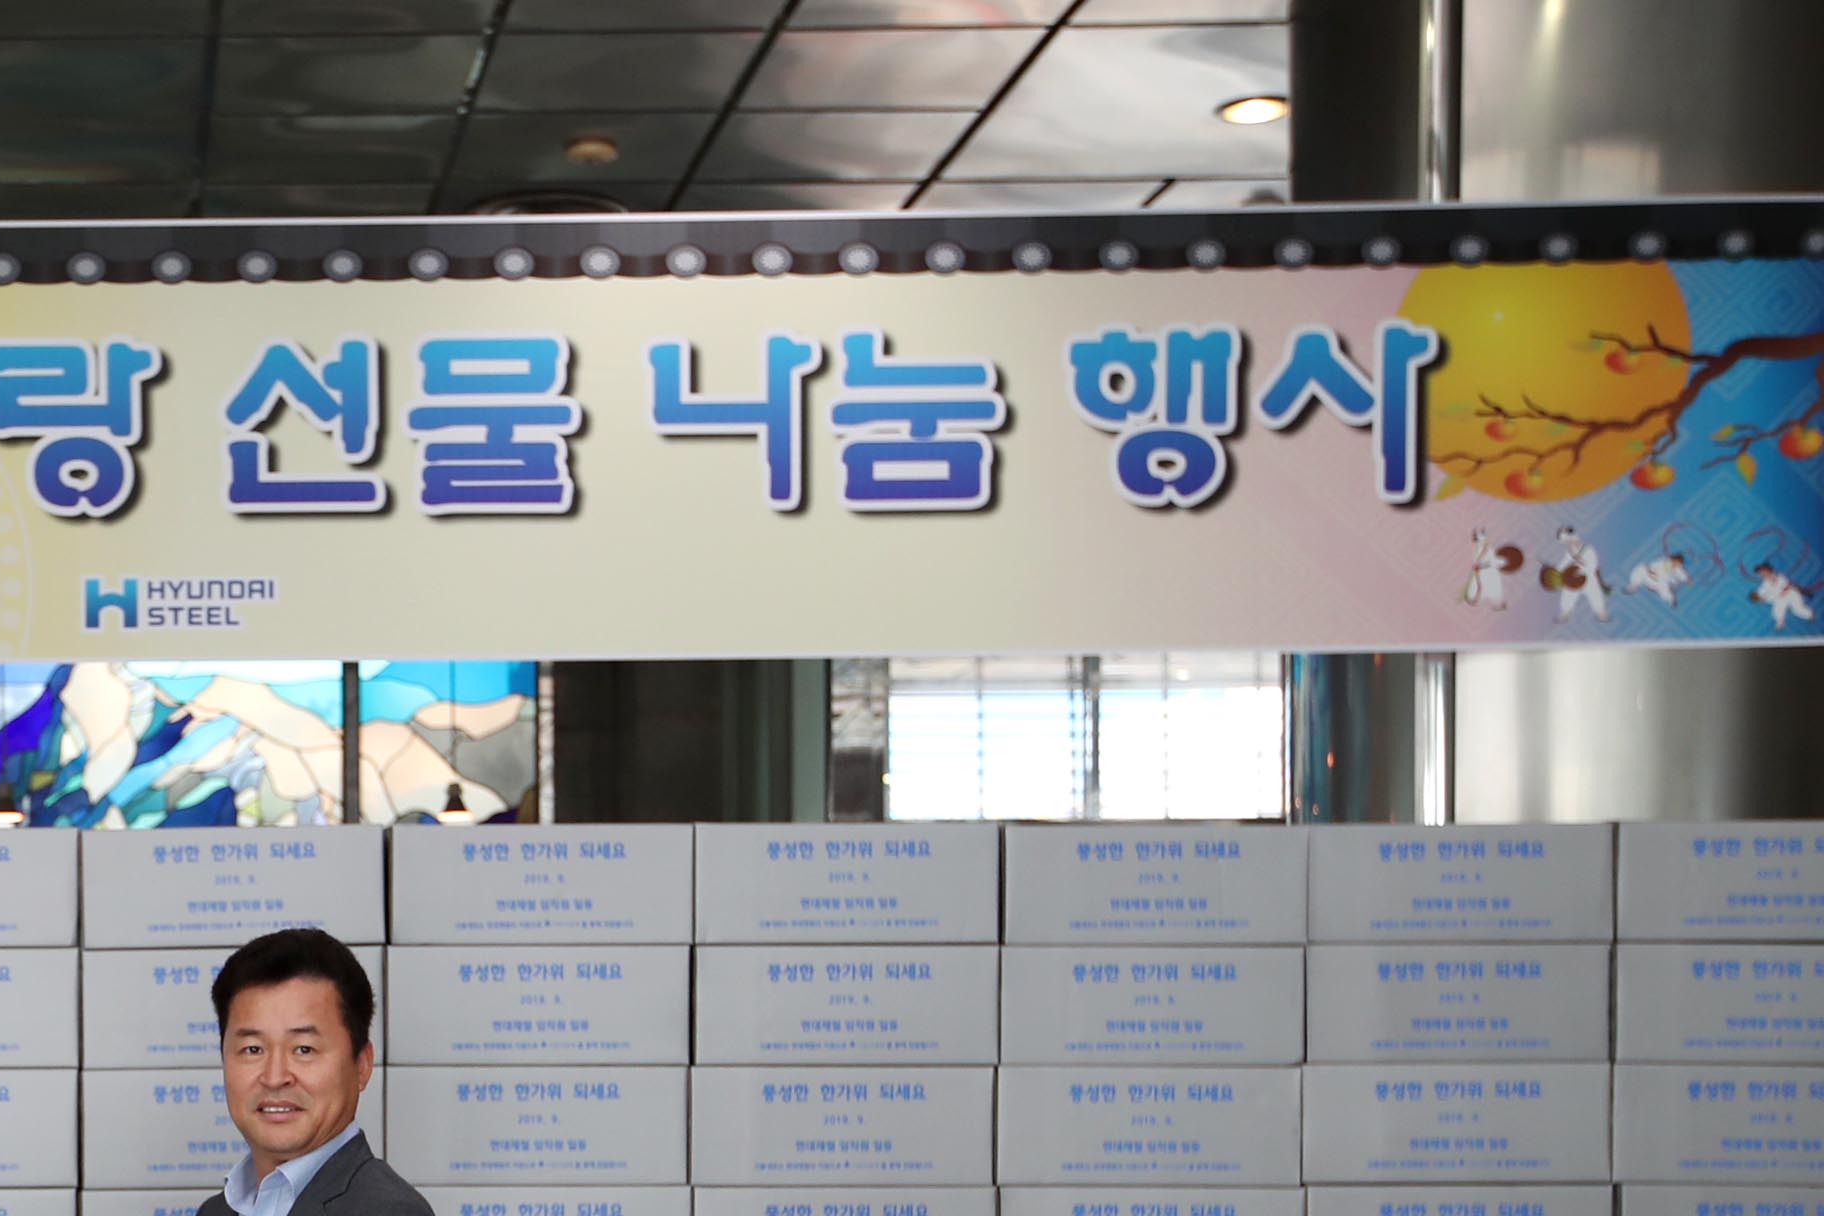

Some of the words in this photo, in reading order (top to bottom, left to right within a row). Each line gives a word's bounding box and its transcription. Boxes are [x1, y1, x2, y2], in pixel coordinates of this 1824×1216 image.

[220, 325, 578, 516] 선물
[644, 322, 1005, 513] 나눔
[1063, 322, 1444, 508] 행사
[147, 580, 274, 600] HYUNDAI
[147, 607, 239, 626] STEEL
[463, 843, 509, 862] 풍성한
[521, 843, 568, 861] 한가위
[580, 842, 625, 859] 되세요
[457, 1083, 503, 1102] 풍성한
[515, 1083, 561, 1100] 한가위
[574, 1083, 619, 1100] 되세요
[763, 1084, 809, 1104] 풍성한
[820, 1084, 867, 1101] 한가위
[880, 1084, 925, 1101] 되세요
